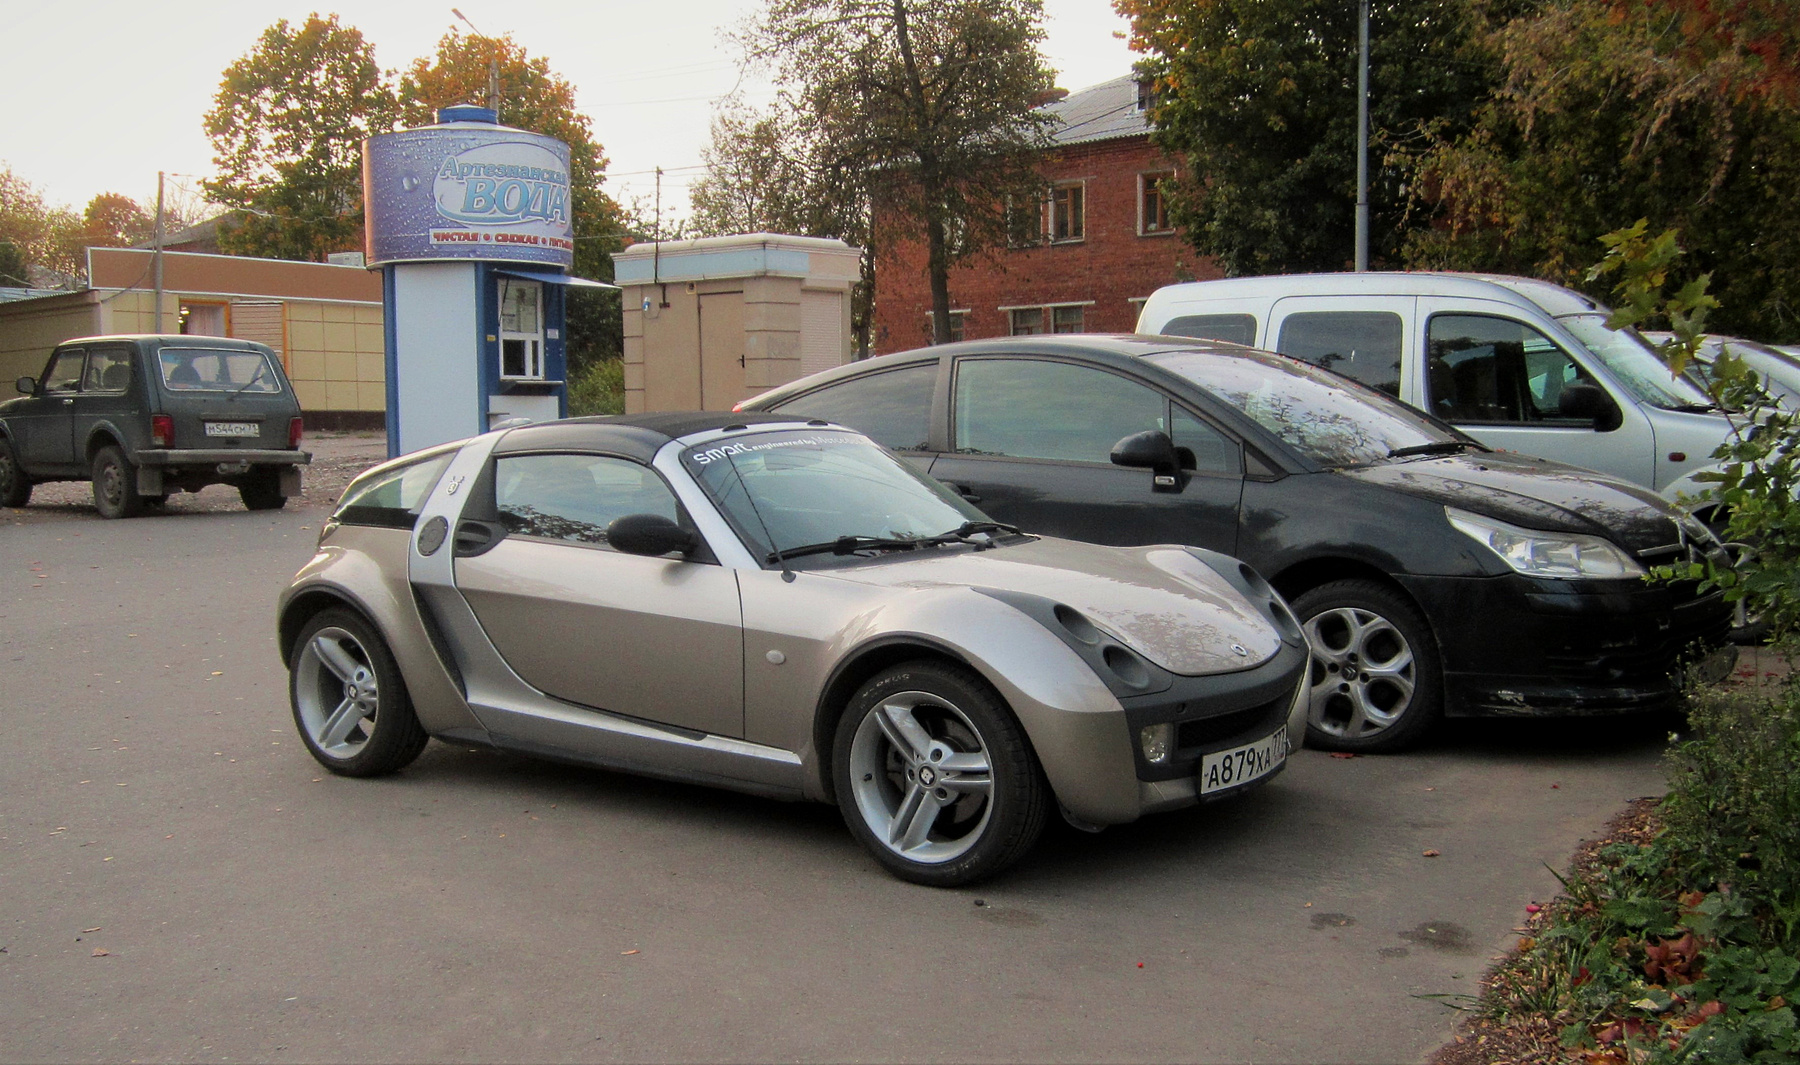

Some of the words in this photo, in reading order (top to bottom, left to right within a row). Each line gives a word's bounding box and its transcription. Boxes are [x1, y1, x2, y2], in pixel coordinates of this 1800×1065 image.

[460, 177, 566, 222] ВОДА
[693, 442, 753, 464] smart
[752, 440, 803, 450] engineered
[1207, 747, 1271, 788] А879ХА
